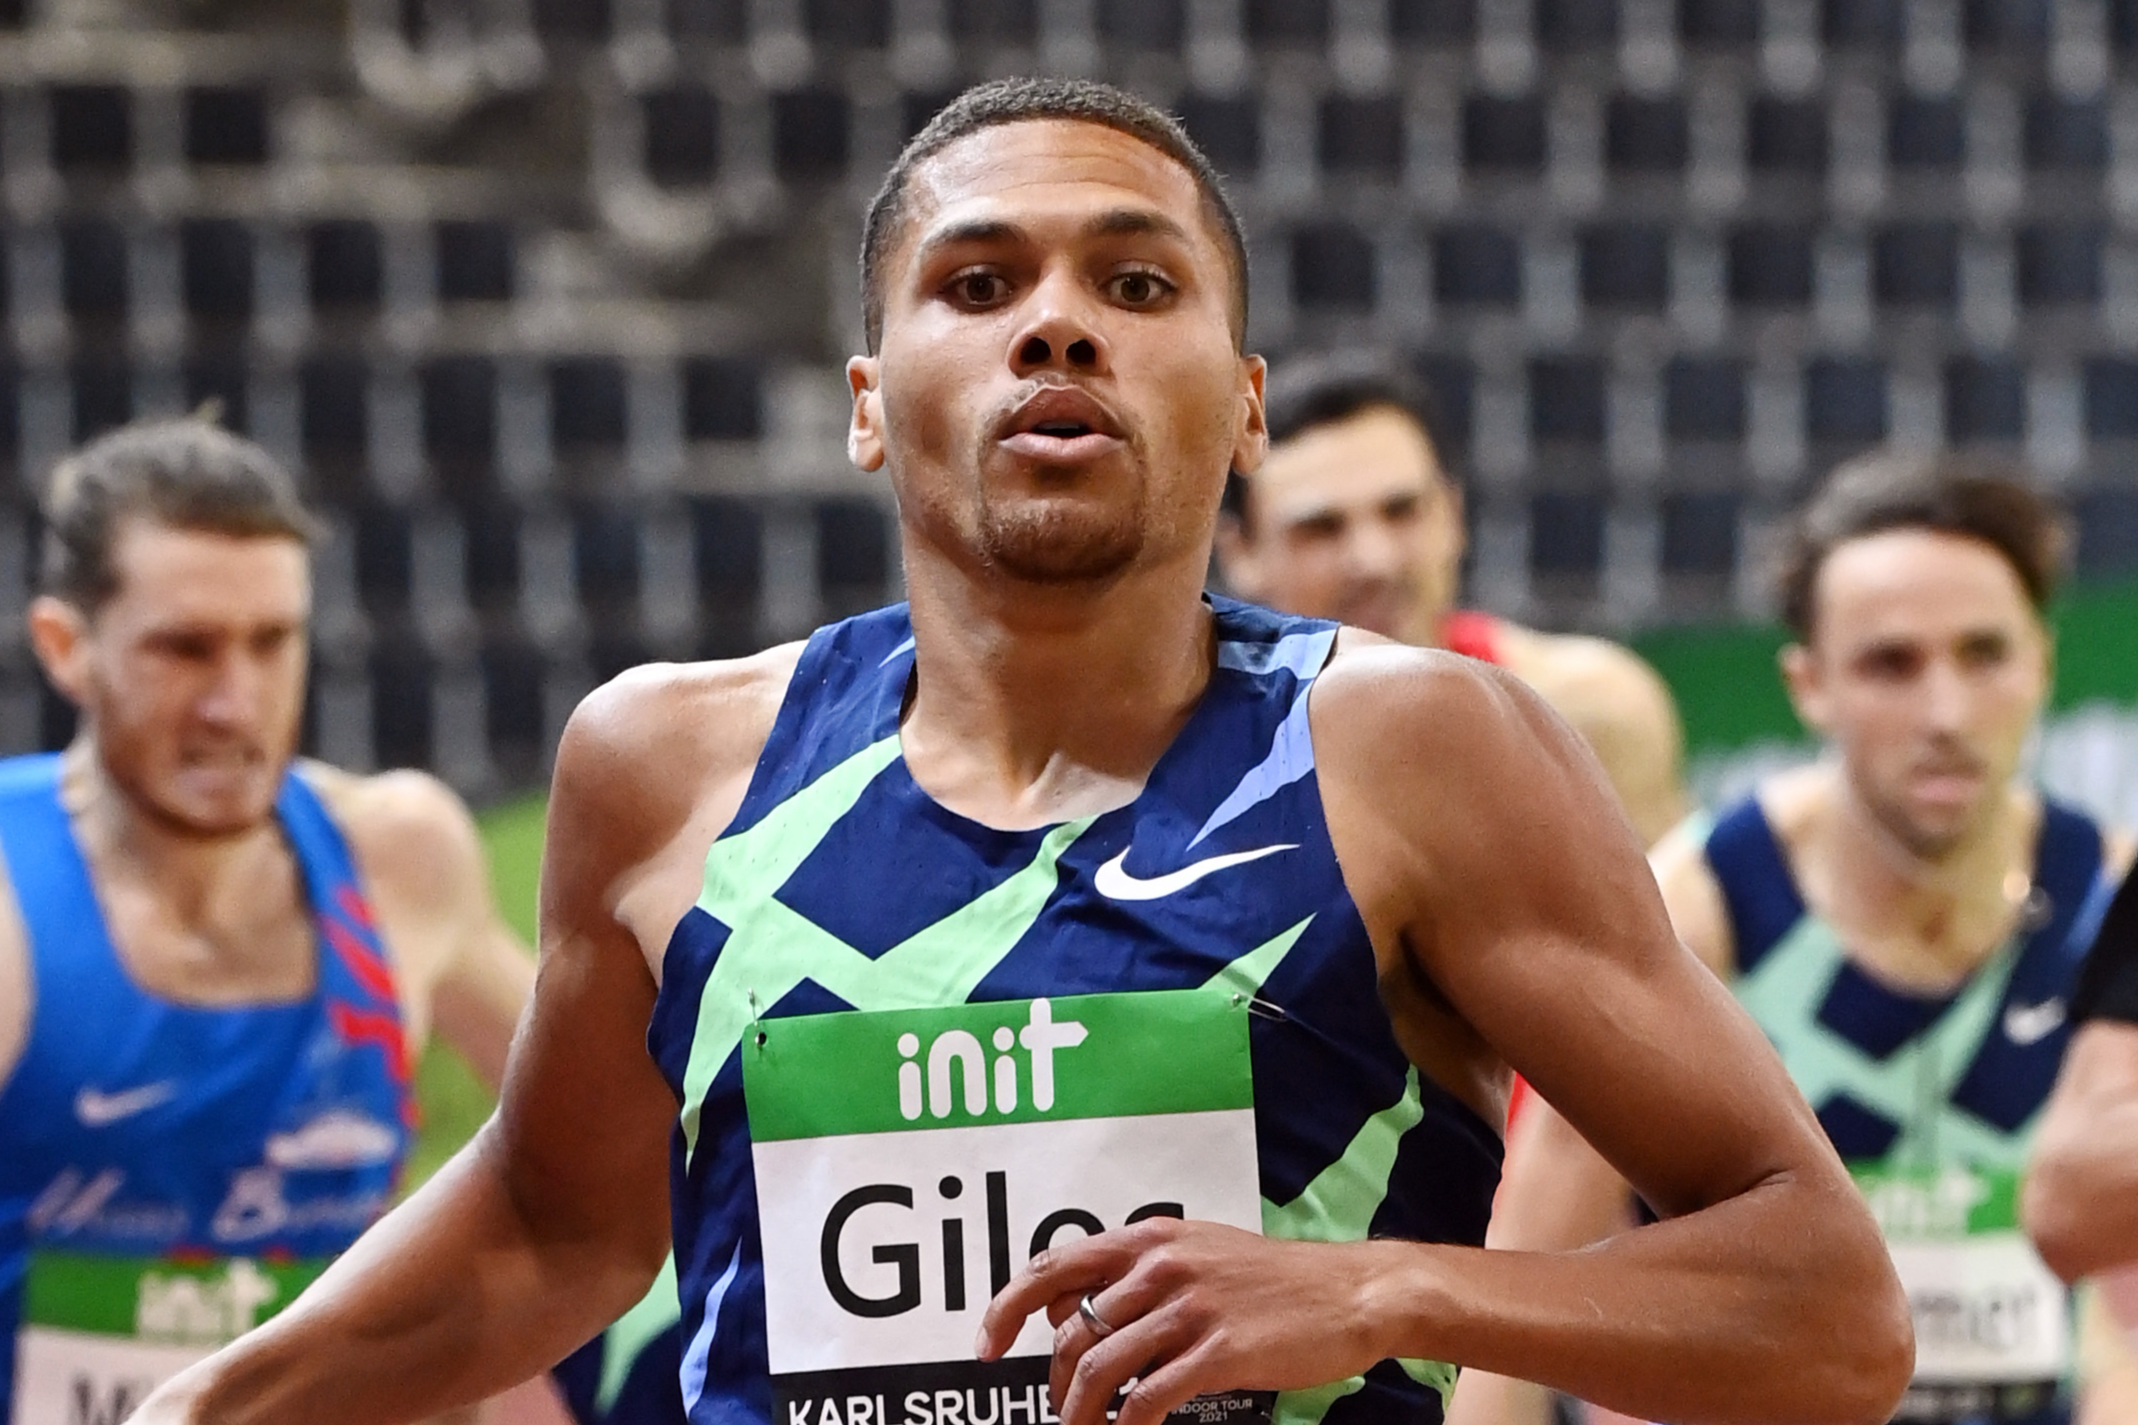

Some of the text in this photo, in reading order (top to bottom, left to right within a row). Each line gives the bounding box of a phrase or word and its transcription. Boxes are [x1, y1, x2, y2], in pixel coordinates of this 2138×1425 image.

[897, 997, 1089, 1120] init
[820, 1170, 1185, 1319] Gil
[1199, 1410, 1228, 1423] 2021
[1221, 1398, 1253, 1411] TOUR
